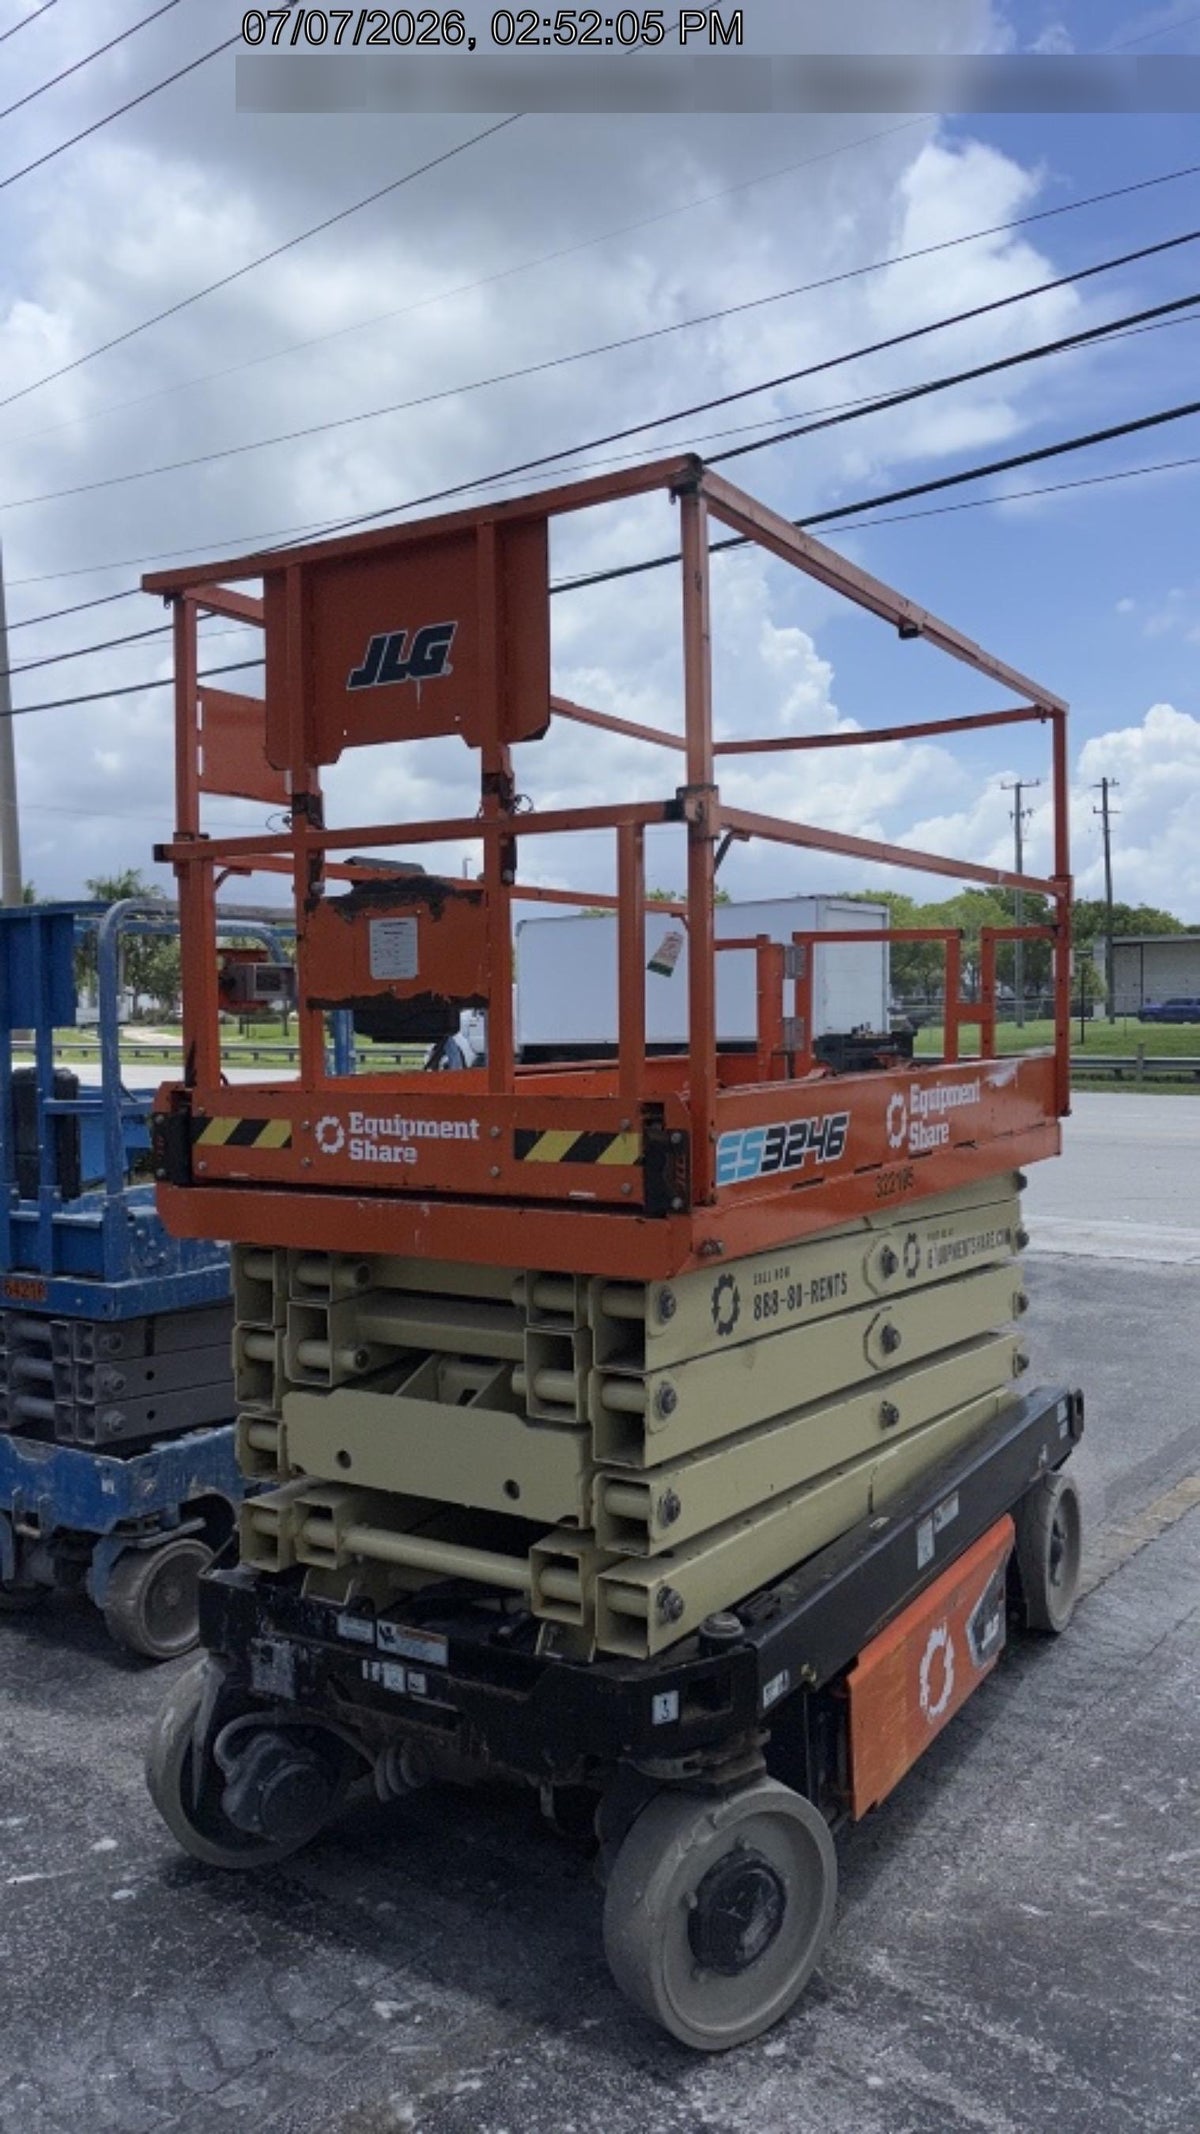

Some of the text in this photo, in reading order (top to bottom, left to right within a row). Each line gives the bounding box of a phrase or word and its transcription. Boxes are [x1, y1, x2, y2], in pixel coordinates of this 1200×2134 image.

[346, 620, 458, 691] JLG
[911, 1077, 980, 1119] Equipment
[348, 1111, 480, 1141] Equipment
[908, 1120, 950, 1151] Share
[349, 1138, 418, 1164] Share
[716, 1110, 851, 1187] ES3246
[753, 1271, 848, 1321] 888-80-RENTS
